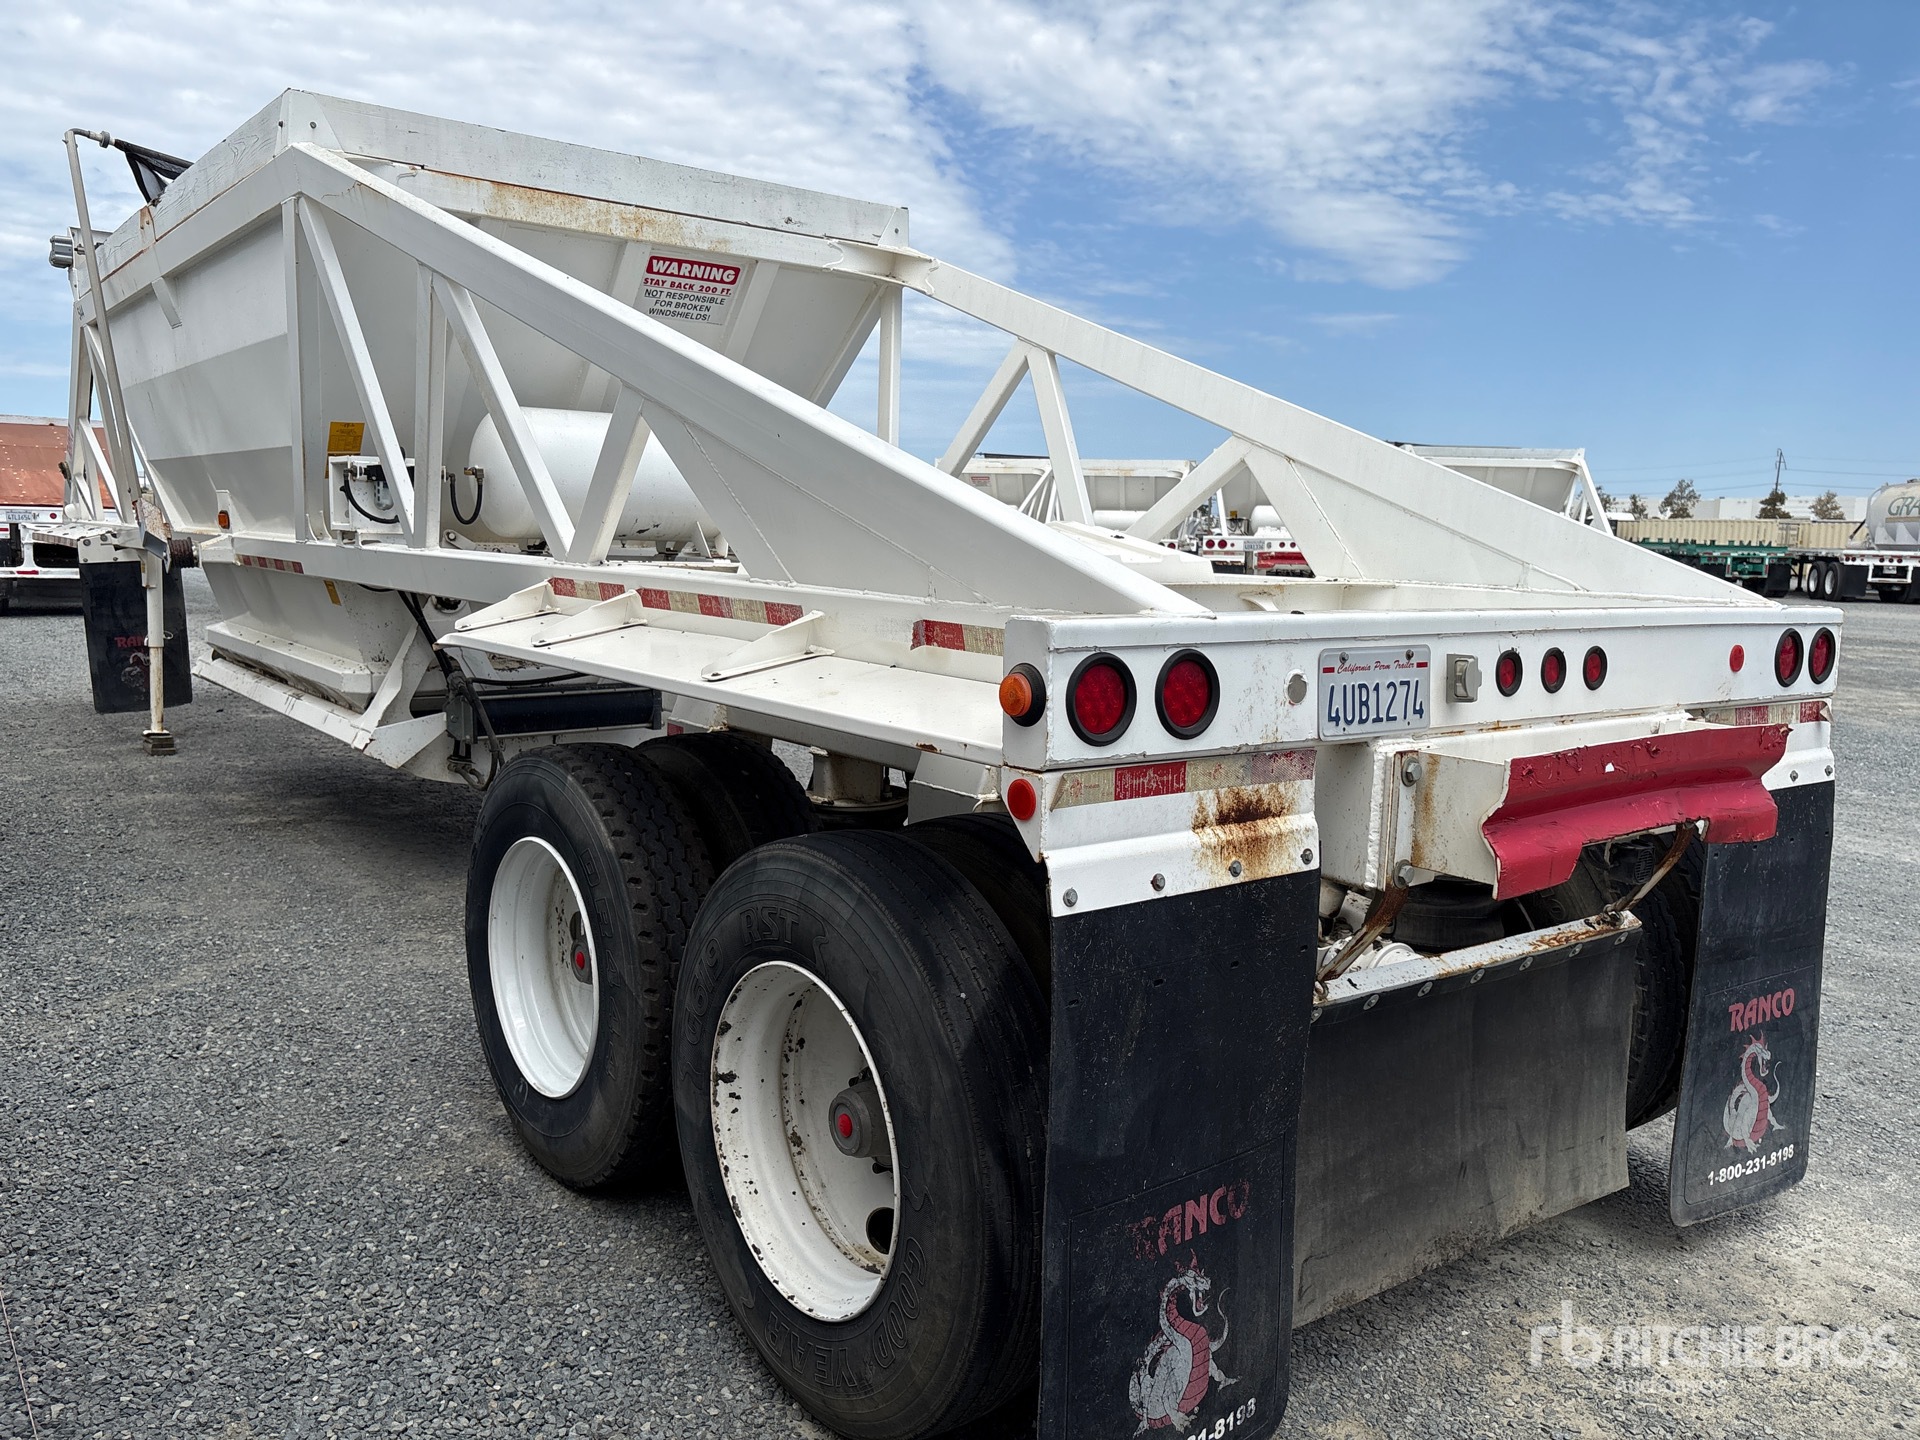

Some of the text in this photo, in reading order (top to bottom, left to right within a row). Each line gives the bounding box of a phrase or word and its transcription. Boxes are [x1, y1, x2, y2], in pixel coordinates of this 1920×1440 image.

[652, 259, 736, 282] WARNING
[643, 277, 732, 296] STAY BACK 200 FT.
[644, 289, 726, 306] NOT RESPONSIBLE
[649, 307, 711, 321] WINDSHIELDS!
[654, 299, 711, 313] FOR BROKEN
[1336, 660, 1414, 674] California Perm Trailer
[1327, 679, 1424, 727] 4UB1274
[739, 906, 801, 946] RST
[1729, 987, 1795, 1032] RANCO
[1708, 1143, 1794, 1186] 1-800-231-8198
[1186, 1397, 1257, 1440] 1-8198
